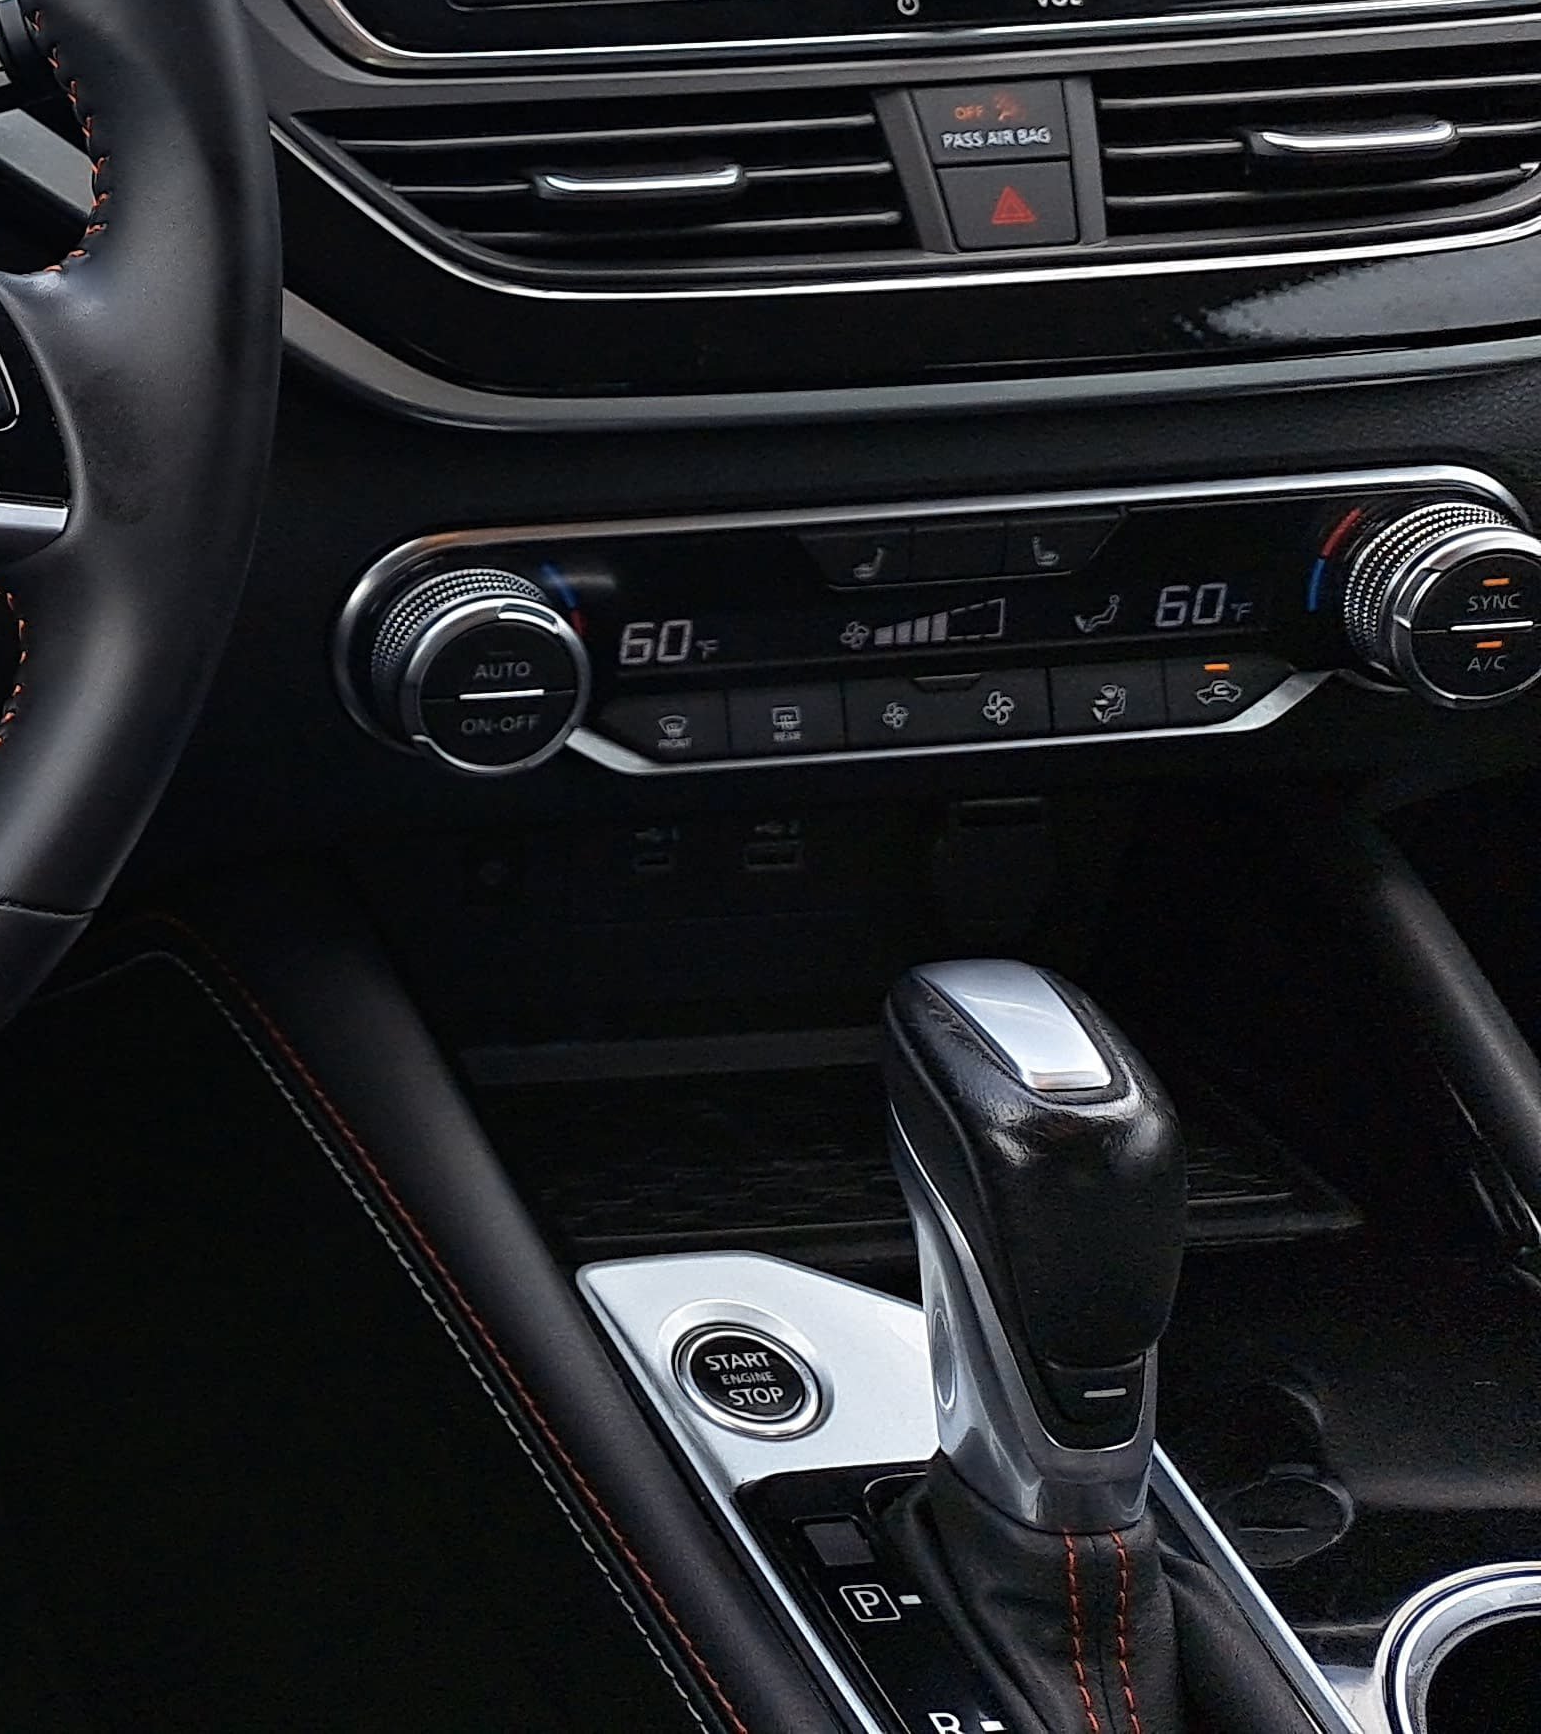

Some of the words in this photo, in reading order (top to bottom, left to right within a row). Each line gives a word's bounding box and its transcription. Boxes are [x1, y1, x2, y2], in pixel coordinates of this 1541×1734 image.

[954, 105, 984, 120] OFF
[941, 130, 984, 148] PASS
[986, 128, 1016, 146] AIR
[1017, 126, 1052, 145] BAG
[1466, 593, 1521, 612] SYNC
[473, 661, 532, 681] AUTO
[1466, 654, 1507, 673] A/C
[704, 1351, 770, 1372] START
[720, 1371, 777, 1386] ENGINE
[728, 1386, 785, 1407] STOP
[853, 1590, 880, 1617] P
[928, 1712, 966, 1734] R
